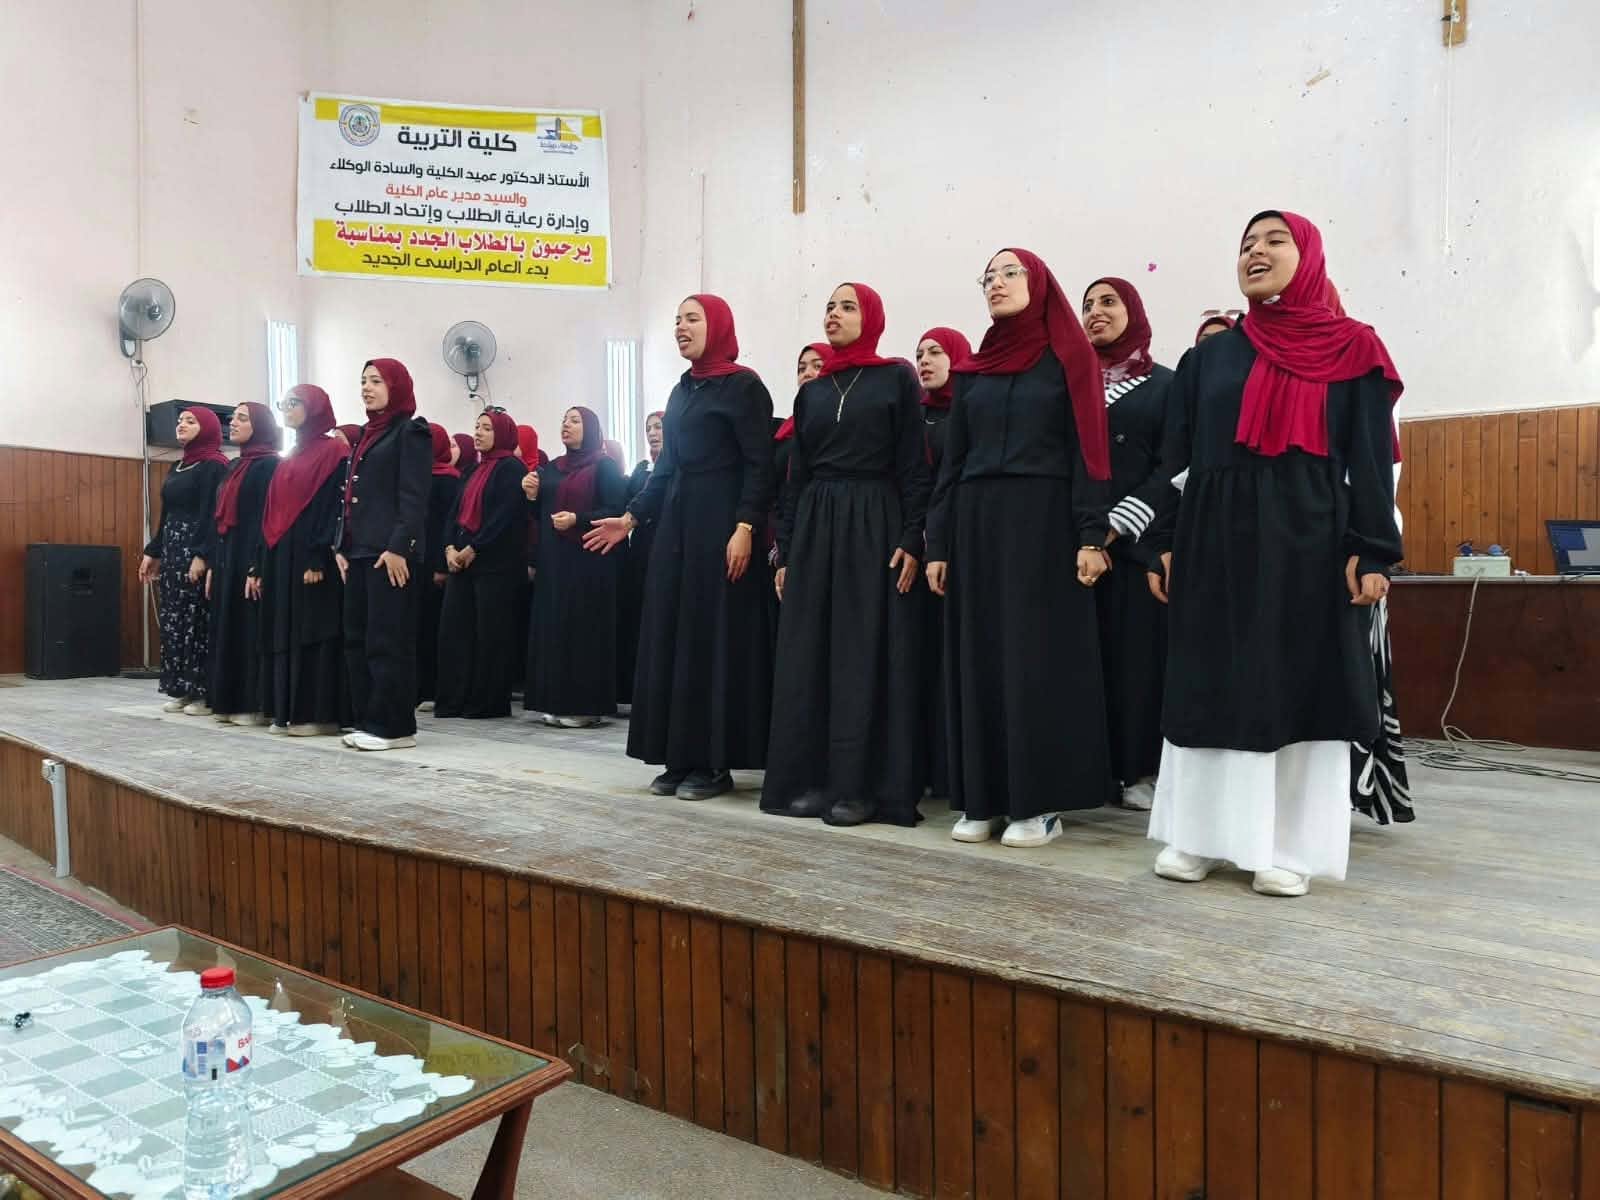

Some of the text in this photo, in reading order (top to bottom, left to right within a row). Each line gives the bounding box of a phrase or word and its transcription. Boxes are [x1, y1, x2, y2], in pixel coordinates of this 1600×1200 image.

[398, 125, 463, 150] التربية
[468, 130, 517, 155] كلية
[329, 158, 590, 188] الأستاذ الدكتور عميد الكلية والسادة الوكلاء
[385, 183, 528, 208] والسيد مدير عام الكلية
[334, 199, 590, 234] وإدارة رعاية الطلاب وإتحاد الطلاب
[335, 220, 592, 263] يرحبون بالطلاب الجدد بمناسبة
[361, 253, 411, 270] الجديد
[485, 260, 522, 276] العام
[525, 264, 549, 280] بدء
